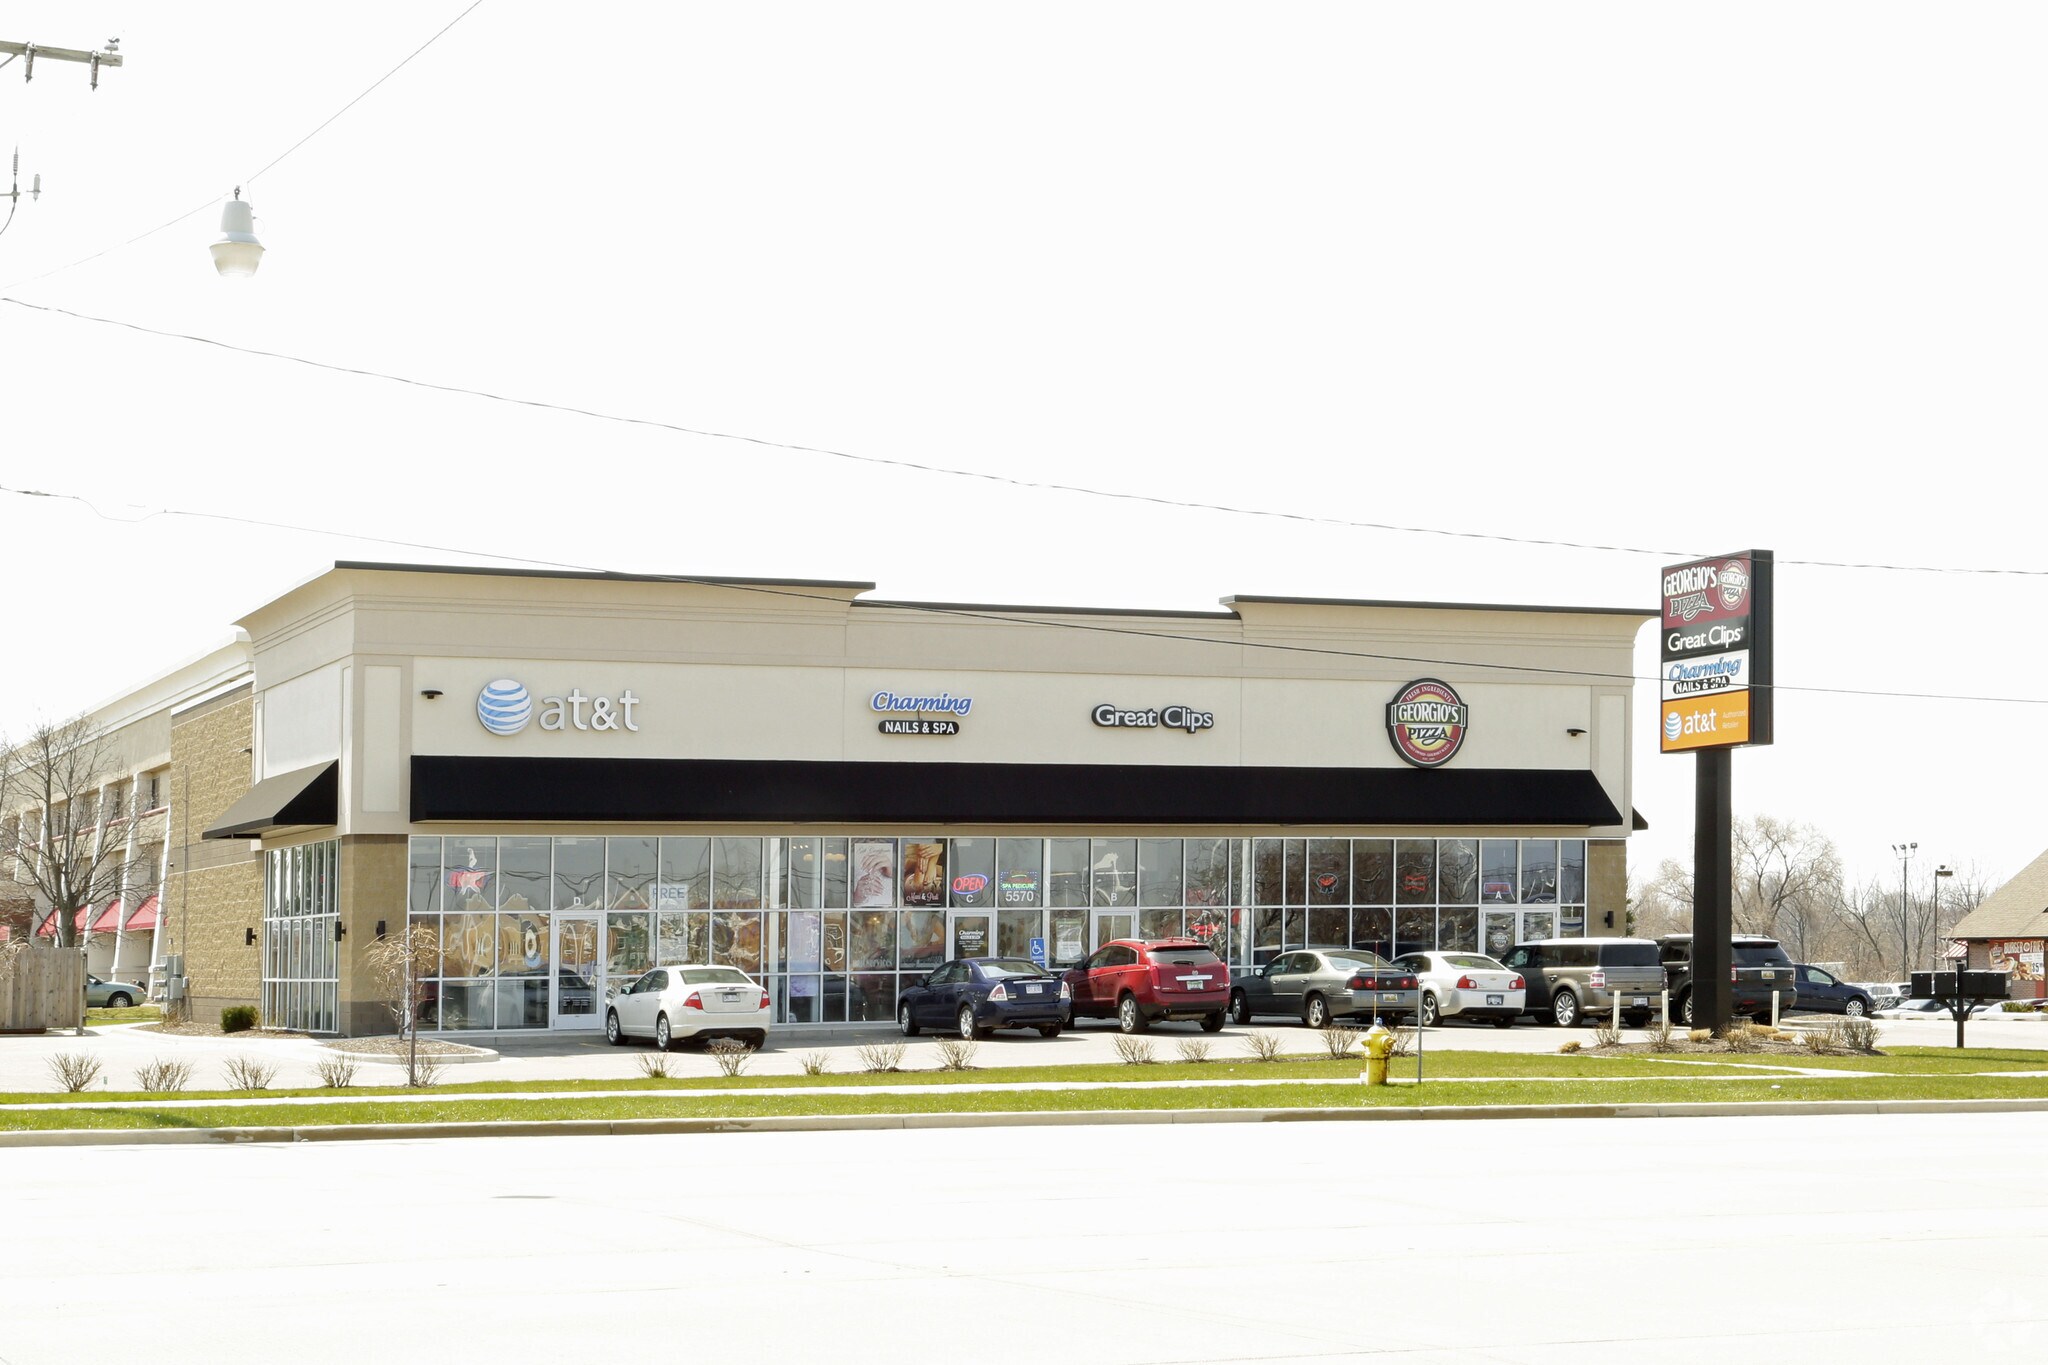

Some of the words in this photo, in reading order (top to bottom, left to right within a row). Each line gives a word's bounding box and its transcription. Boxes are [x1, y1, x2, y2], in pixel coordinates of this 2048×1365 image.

[1663, 565, 1717, 597] GEORGIO'S
[1720, 572, 1747, 587] GEORGIO'S
[1670, 591, 1714, 621] PIZZA
[1667, 632, 1707, 651] Great
[1708, 625, 1742, 648] Clips
[1669, 657, 1742, 681] Charming
[1675, 681, 1700, 694] NAILS
[539, 688, 640, 732] at&t
[871, 690, 973, 717] Charming
[1398, 702, 1459, 722] GEORGIO'S
[1094, 704, 1157, 727] Great
[1164, 706, 1214, 733] Clips
[1684, 708, 1717, 735] at&t
[885, 721, 919, 733] NAILS
[921, 723, 930, 734] &
[932, 723, 955, 734] SPA
[1407, 727, 1455, 746] PIZZA
[952, 876, 985, 892] OPEN
[573, 896, 582, 906] D
[652, 887, 685, 899] FREE
[966, 894, 974, 903] C
[1005, 890, 1034, 902] 5570
[1110, 892, 1118, 902] B
[1495, 890, 1502, 900] A
